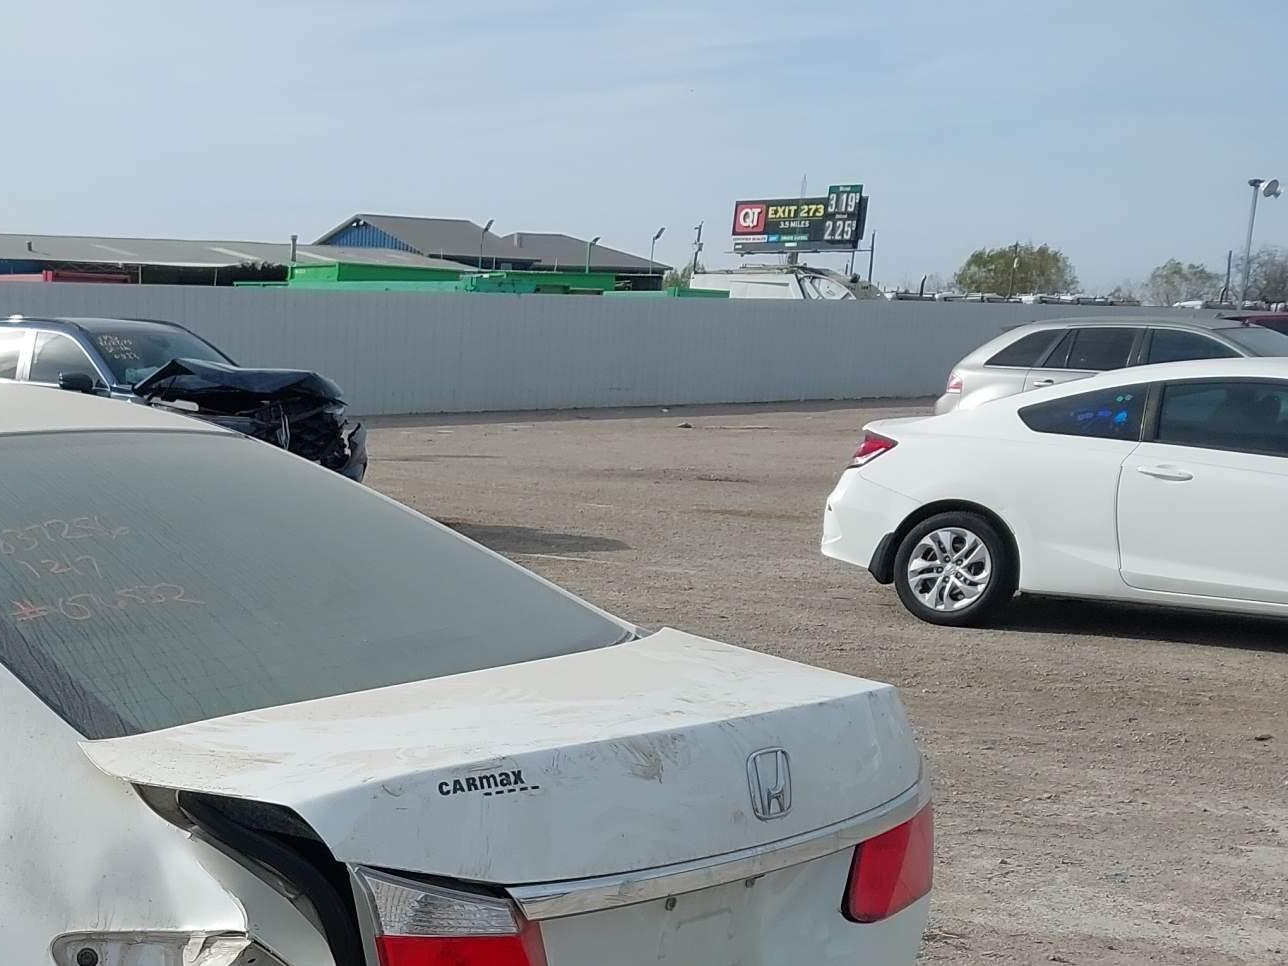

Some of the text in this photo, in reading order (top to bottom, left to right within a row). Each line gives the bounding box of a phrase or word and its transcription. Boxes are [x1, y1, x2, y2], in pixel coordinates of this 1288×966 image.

[739, 208, 762, 228] QT
[768, 204, 825, 218] EXIT 273
[790, 220, 810, 228] MILES
